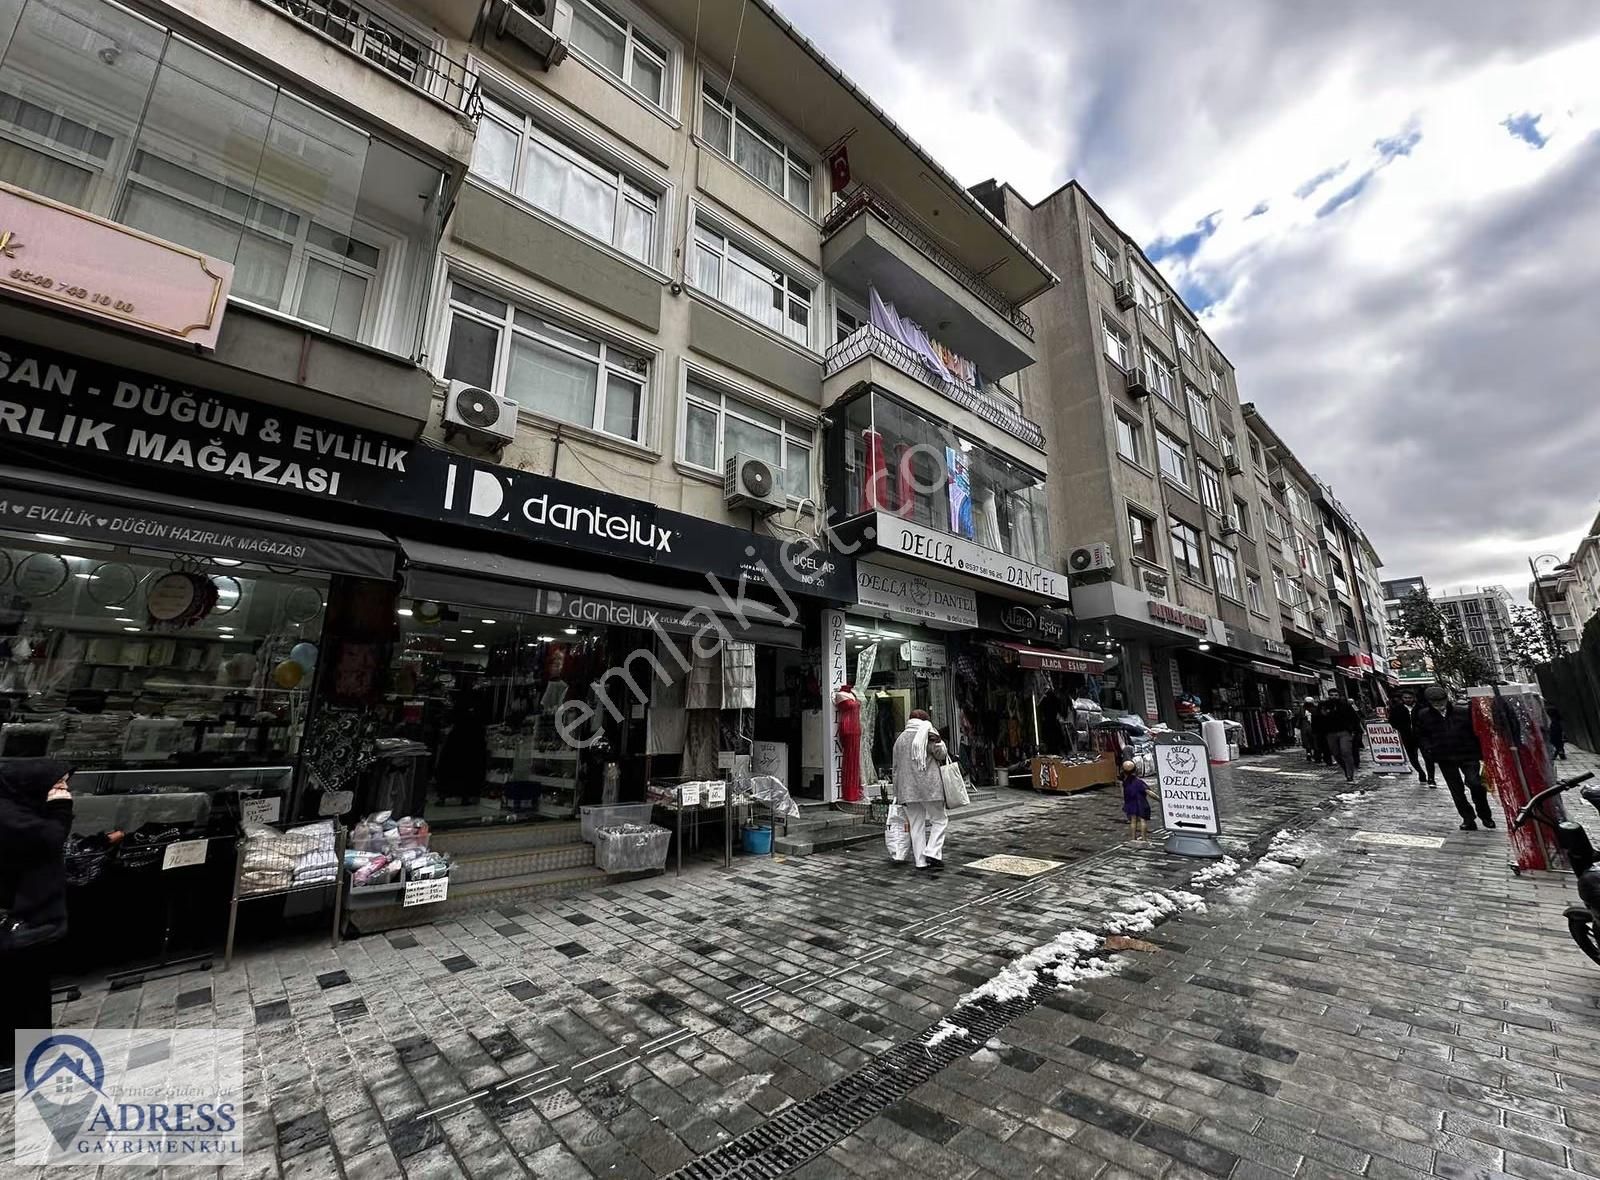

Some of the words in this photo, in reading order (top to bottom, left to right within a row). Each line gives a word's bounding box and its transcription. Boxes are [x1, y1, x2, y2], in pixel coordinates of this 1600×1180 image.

[112, 381, 249, 436] DÜĞÜN
[258, 417, 281, 444] &
[293, 425, 408, 472] EVLİLİK
[126, 429, 341, 496] MAĞAZASI
[26, 505, 94, 528] EVLİLİK
[110, 517, 167, 538] DÜĞÜN
[169, 526, 234, 550] HAZIRLIK
[238, 536, 306, 559] MAĞAZASI
[523, 494, 672, 553] dantelux
[792, 552, 818, 570] ÜÇEL
[900, 530, 954, 565] DELLA
[859, 572, 907, 597] DELLA
[934, 590, 976, 613] DANTEL
[1007, 566, 1056, 596] DANTEL
[569, 596, 659, 629] dantelux
[832, 615, 843, 685] DELLA
[1370, 736, 1400, 747] KUMAŞ
[1163, 775, 1207, 788] DELLA
[1164, 789, 1211, 801] DANTEL
